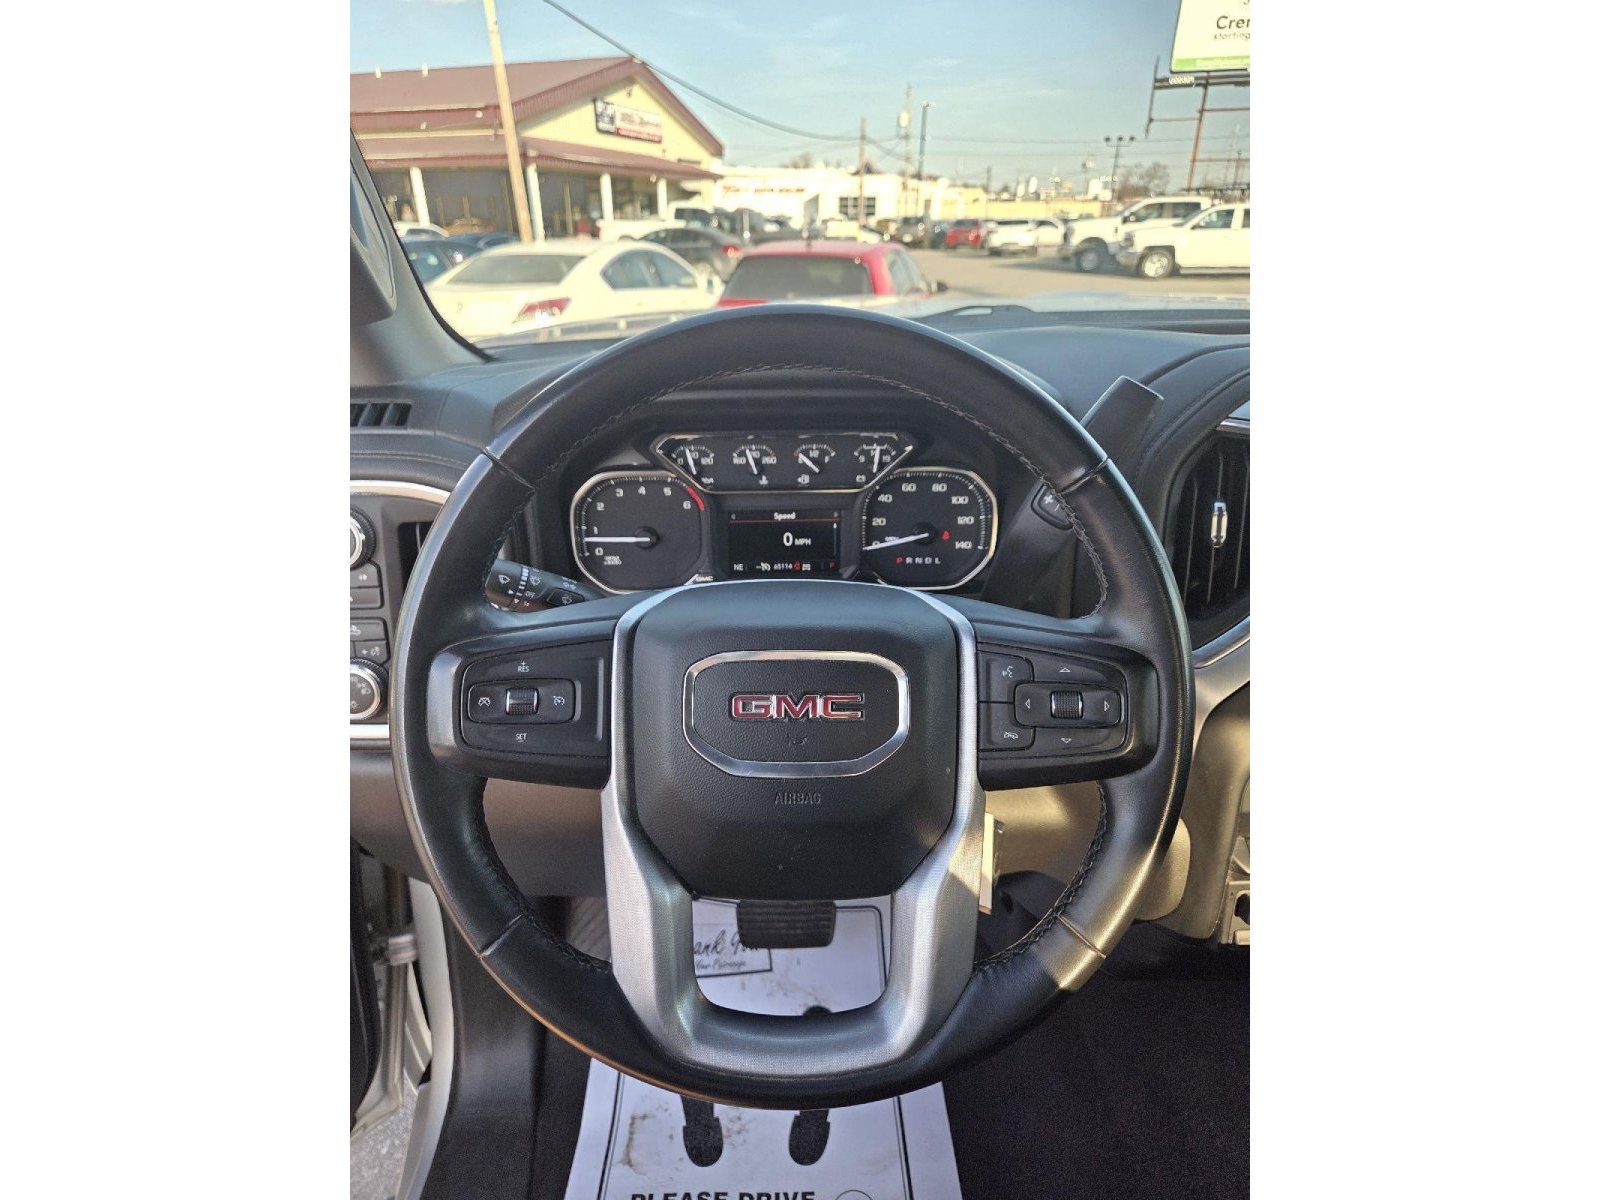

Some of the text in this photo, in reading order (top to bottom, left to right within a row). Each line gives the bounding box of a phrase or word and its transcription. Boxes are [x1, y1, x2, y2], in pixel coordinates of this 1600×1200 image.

[638, 486, 646, 496] 4
[663, 487, 672, 496] 5
[901, 482, 917, 492] 60
[931, 482, 947, 492] 80
[615, 488, 624, 497] 3
[878, 494, 893, 503] 40
[951, 496, 969, 505] 100
[596, 502, 605, 511] 2
[683, 501, 692, 510] 6
[773, 512, 796, 521] Speed
[957, 516, 975, 525] 120
[872, 517, 886, 526] 20
[783, 532, 793, 546] 0
[955, 541, 972, 549] 140
[595, 547, 604, 556] 0
[733, 563, 744, 571] NE
[517, 665, 530, 673] RES
[732, 694, 862, 719] GMC
[774, 791, 821, 805] AIRBAG
